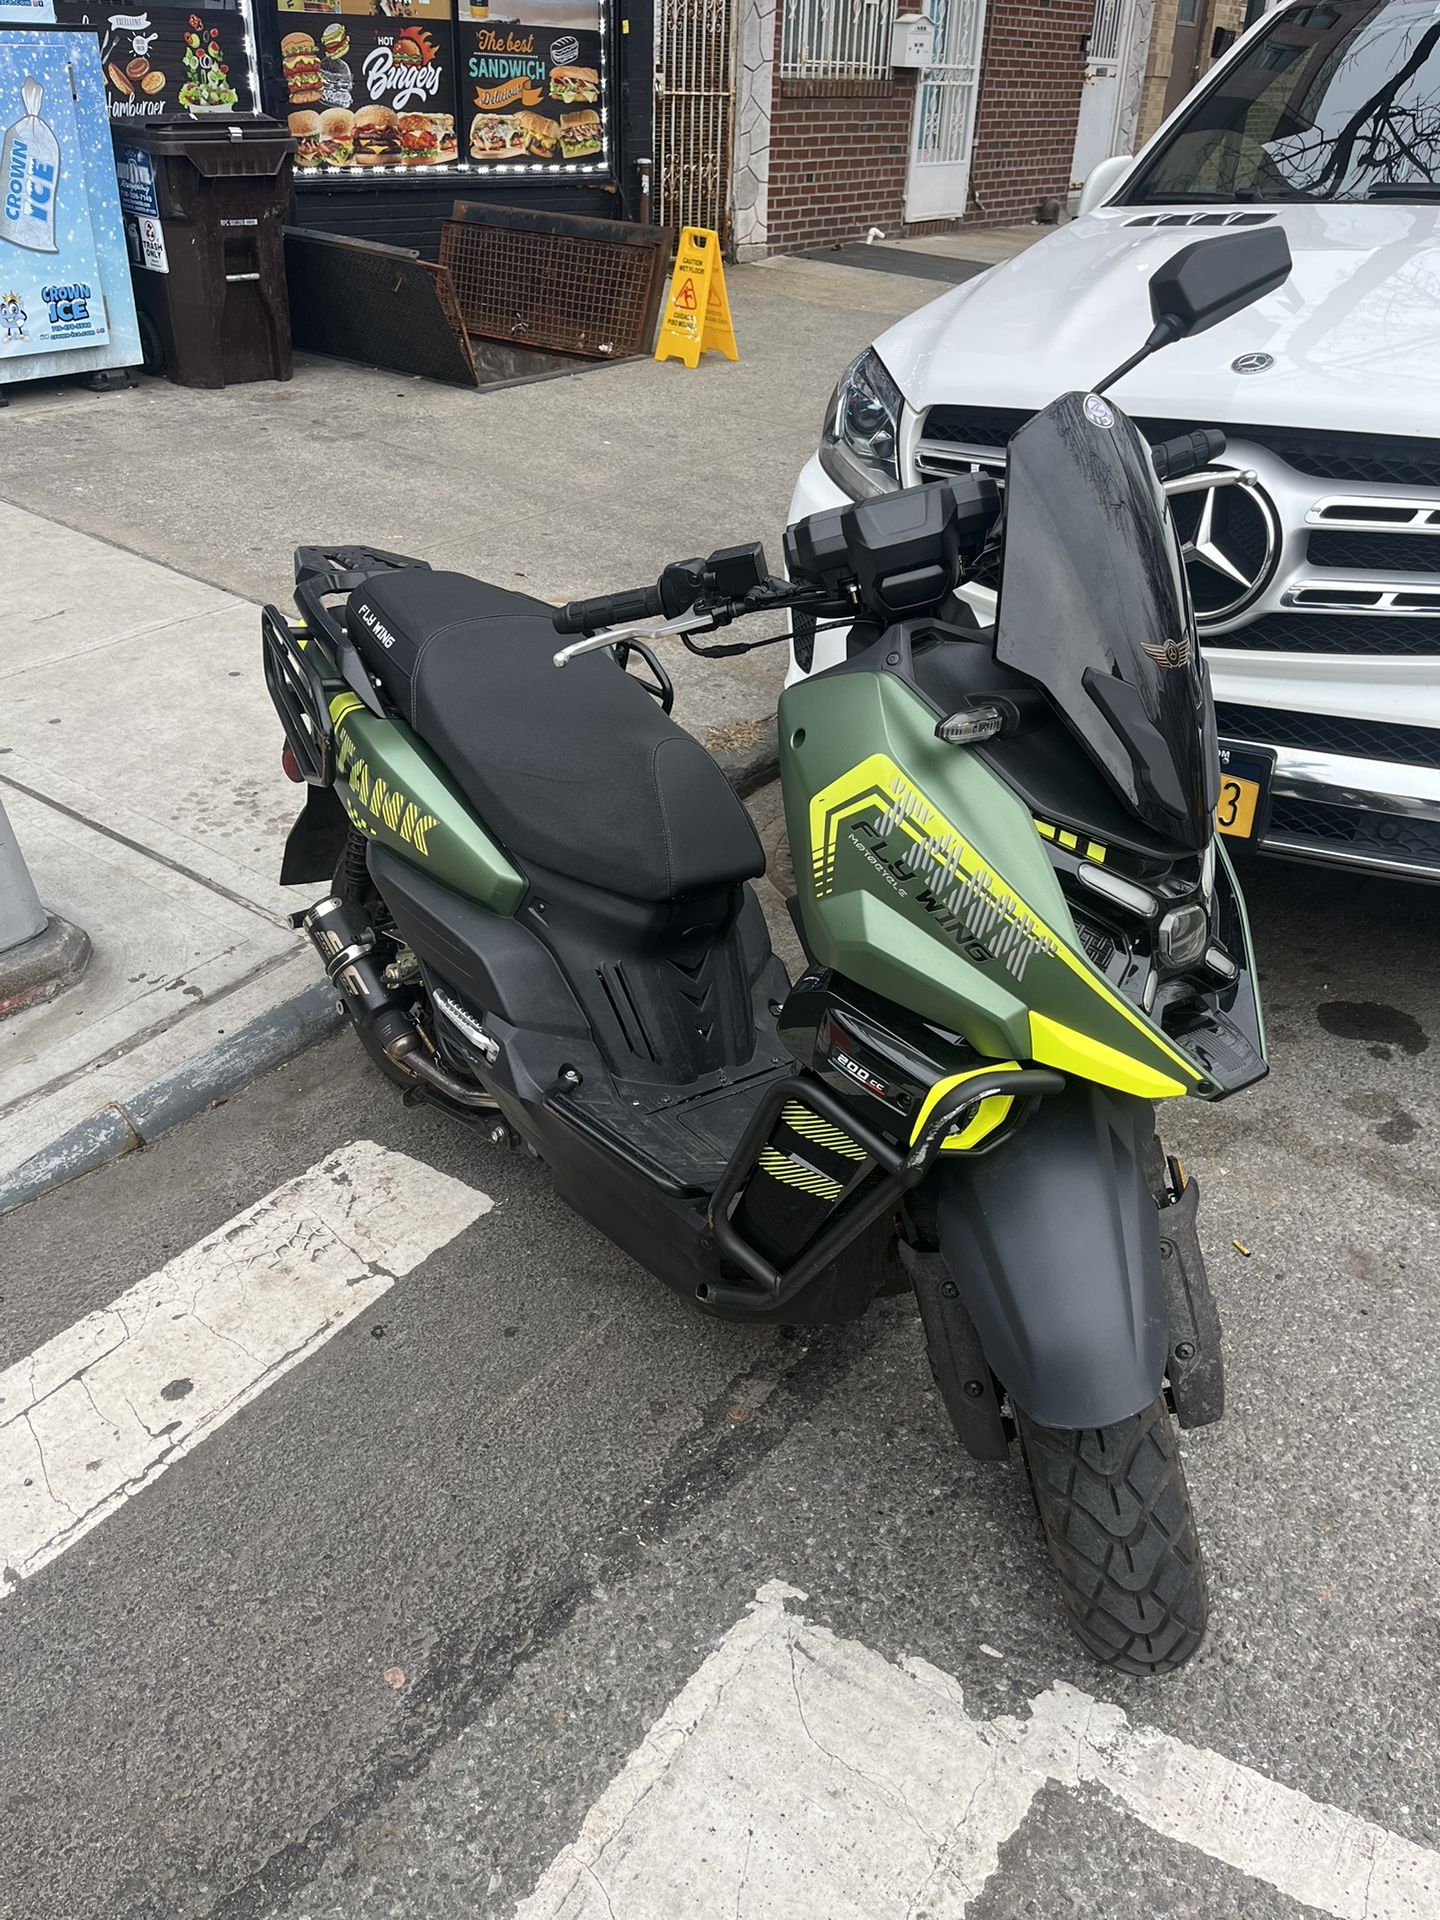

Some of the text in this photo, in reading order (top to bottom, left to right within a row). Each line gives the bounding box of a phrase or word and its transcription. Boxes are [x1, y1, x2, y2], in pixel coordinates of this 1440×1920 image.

[115, 17, 142, 26] EXCELLENT
[377, 36, 394, 46] HOT
[477, 29, 534, 53] The best
[362, 47, 443, 111] Burgers
[469, 57, 546, 80] SANDWICH
[5, 139, 28, 221] CROWN
[24, 157, 55, 221] ICE
[143, 240, 164, 252] TRASH
[146, 249, 162, 259] ONLY
[679, 265, 689, 273] WET
[689, 266, 705, 275] FLOOR
[682, 257, 703, 267] CAUTION
[41, 284, 91, 303] CROWN
[48, 299, 90, 323] ICE
[358, 604, 396, 649] FLY WING
[1218, 781, 1242, 828] 3
[850, 820, 997, 965] FLY WING
